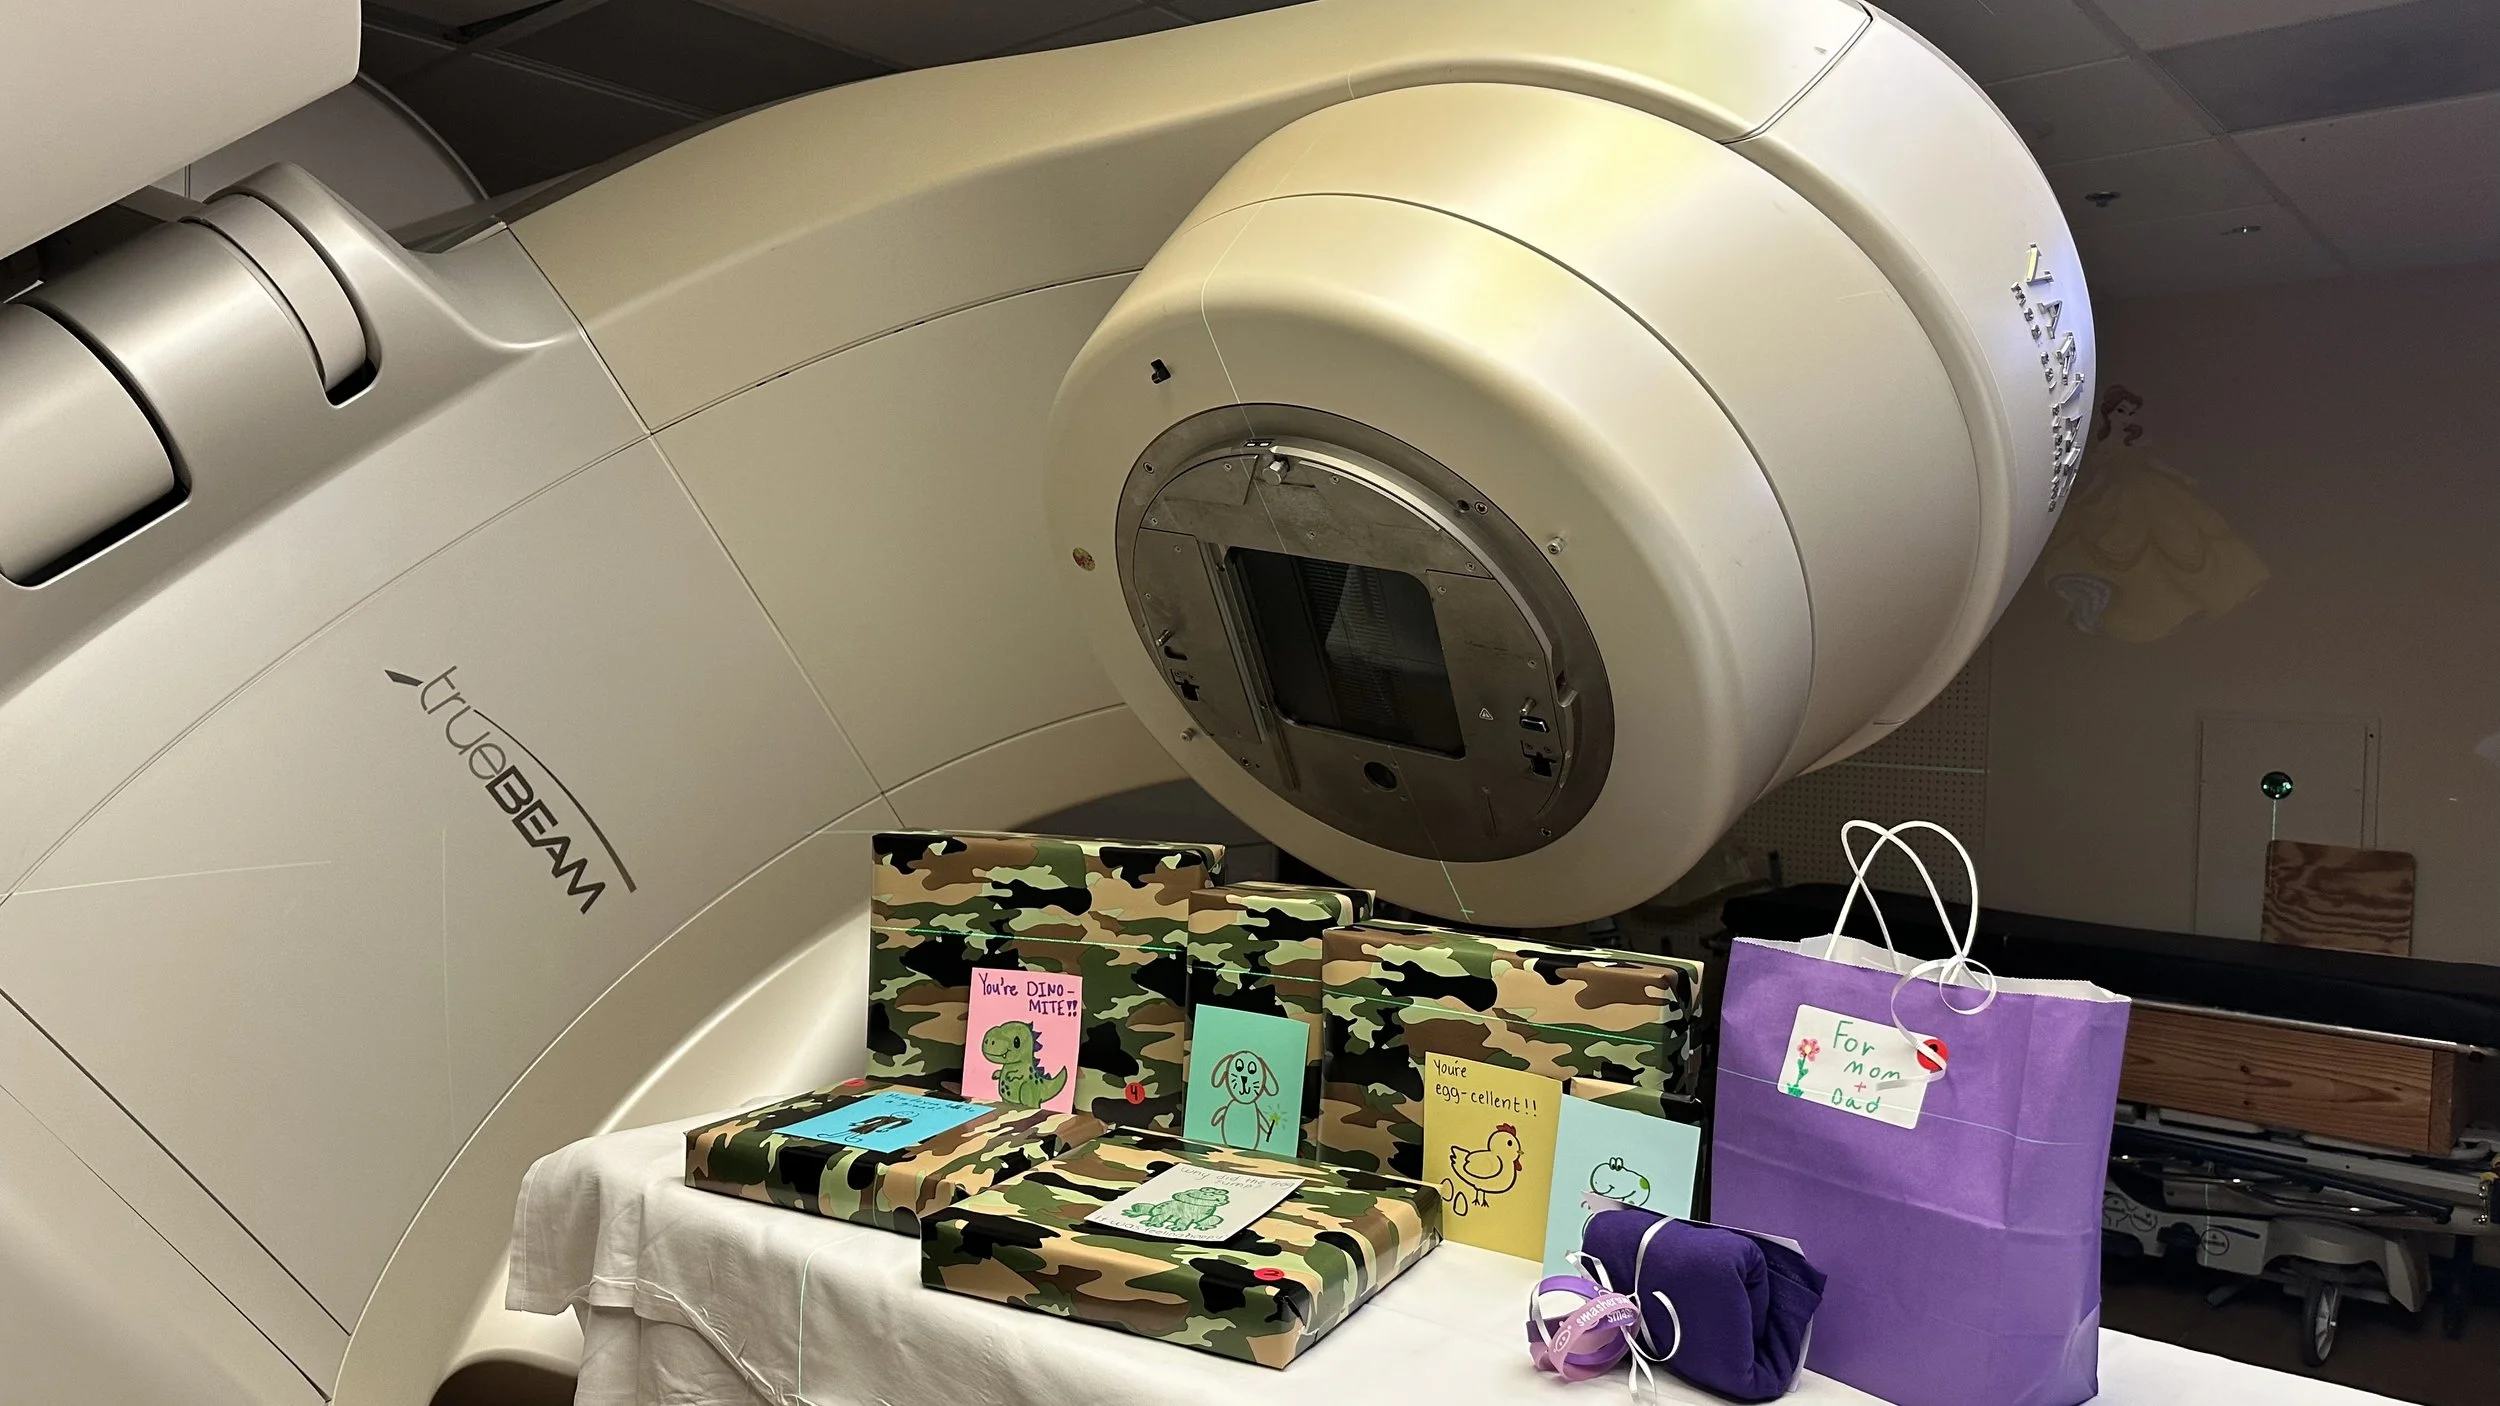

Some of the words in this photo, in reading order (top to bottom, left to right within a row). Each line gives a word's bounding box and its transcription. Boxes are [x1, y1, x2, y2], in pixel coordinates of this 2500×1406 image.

[978, 972, 1019, 997] You're
[1028, 998, 1079, 1018] MITE!!
[1832, 1019, 1876, 1057] For
[1433, 1058, 1468, 1079] You're
[1129, 1084, 1139, 1101] 4
[1830, 1087, 1882, 1114] Dad
